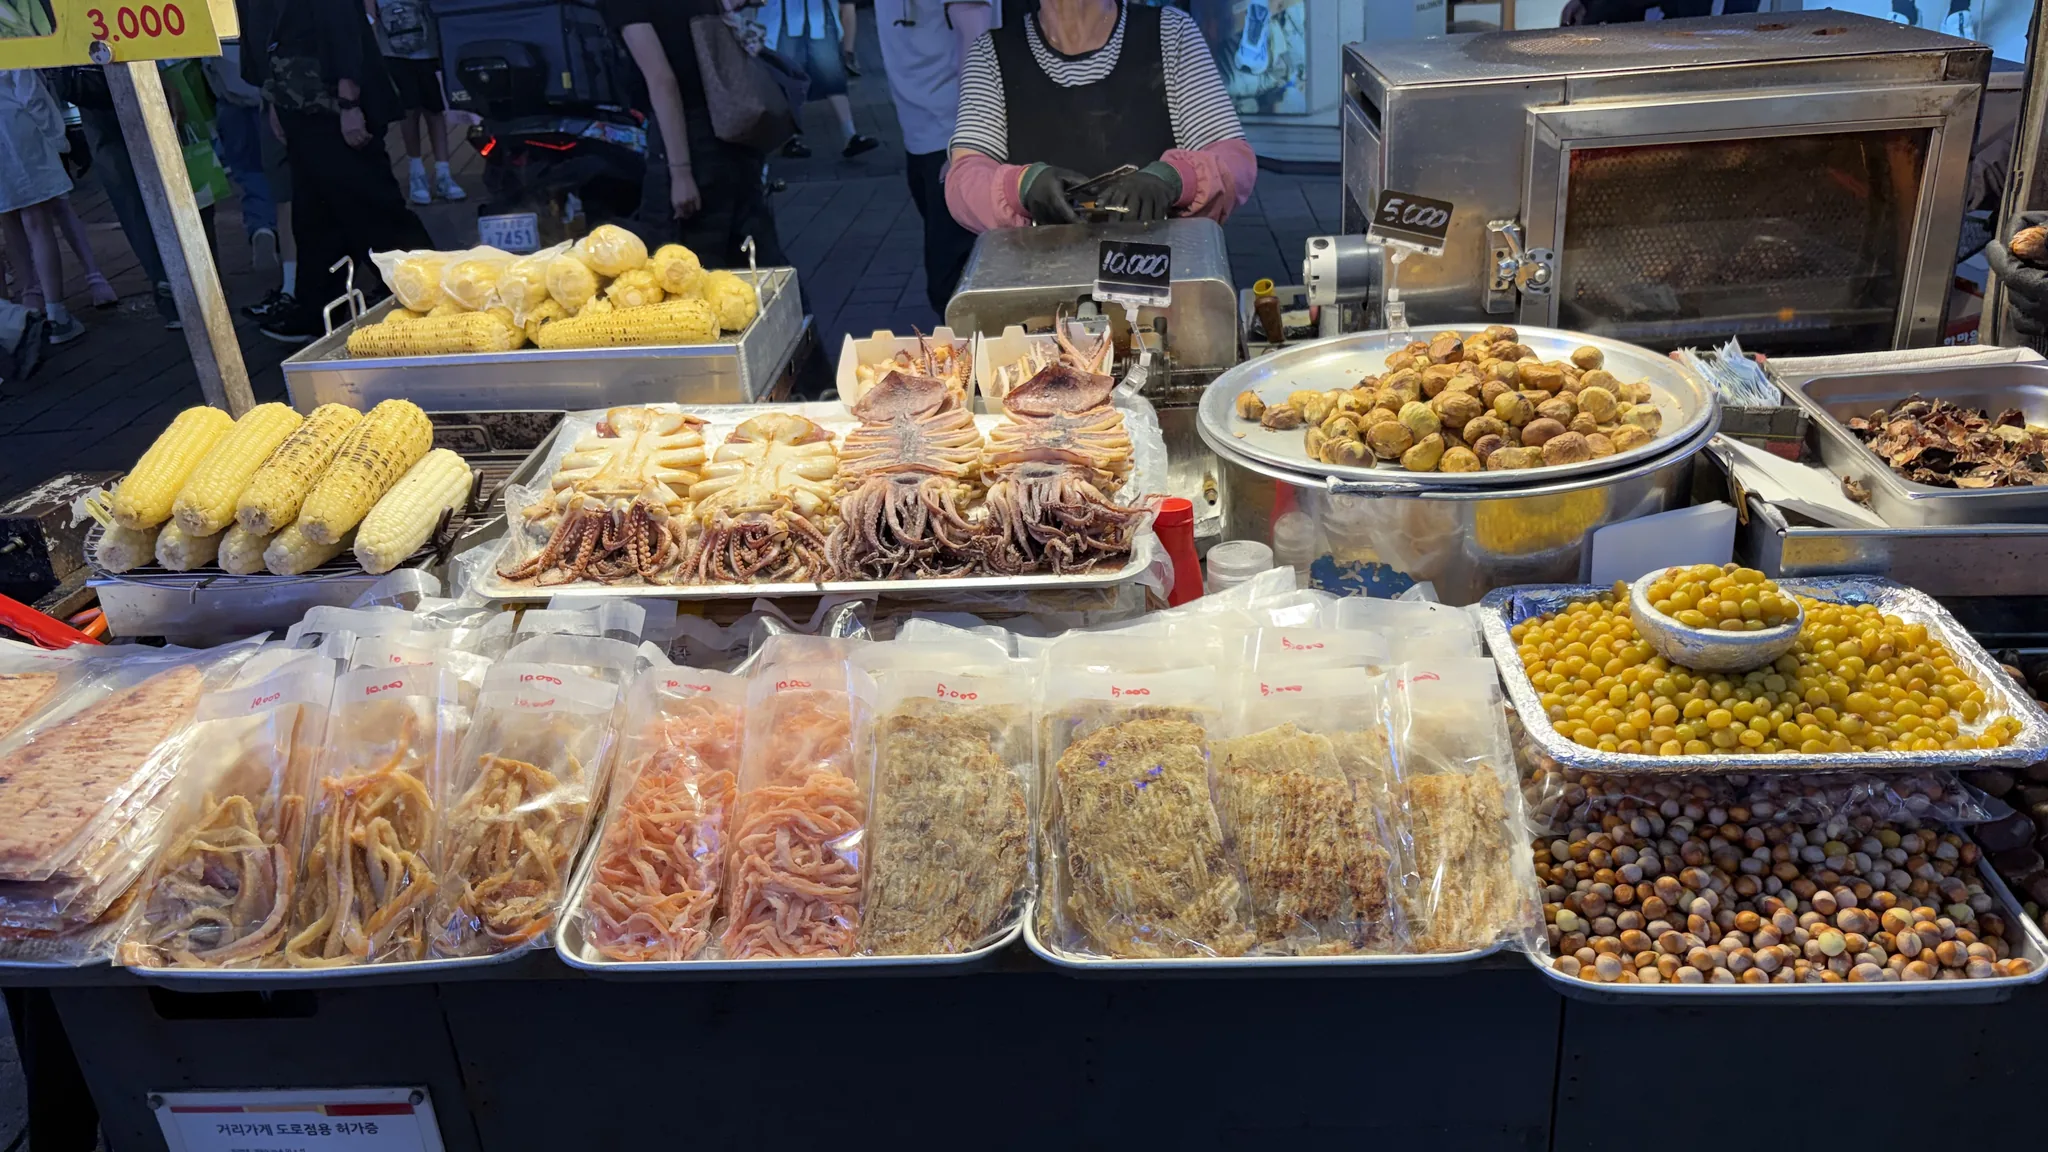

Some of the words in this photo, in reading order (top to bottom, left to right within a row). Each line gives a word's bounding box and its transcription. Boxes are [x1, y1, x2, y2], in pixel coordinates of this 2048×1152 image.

[86, 3, 185, 42] 3.000
[1383, 198, 1448, 228] 5.000
[936, 683, 978, 700] 5.000
[1111, 685, 1151, 698] 5.000
[216, 1123, 273, 1137] 거리가게
[276, 1122, 332, 1136] 도로점용
[337, 1121, 379, 1135] 허가증
